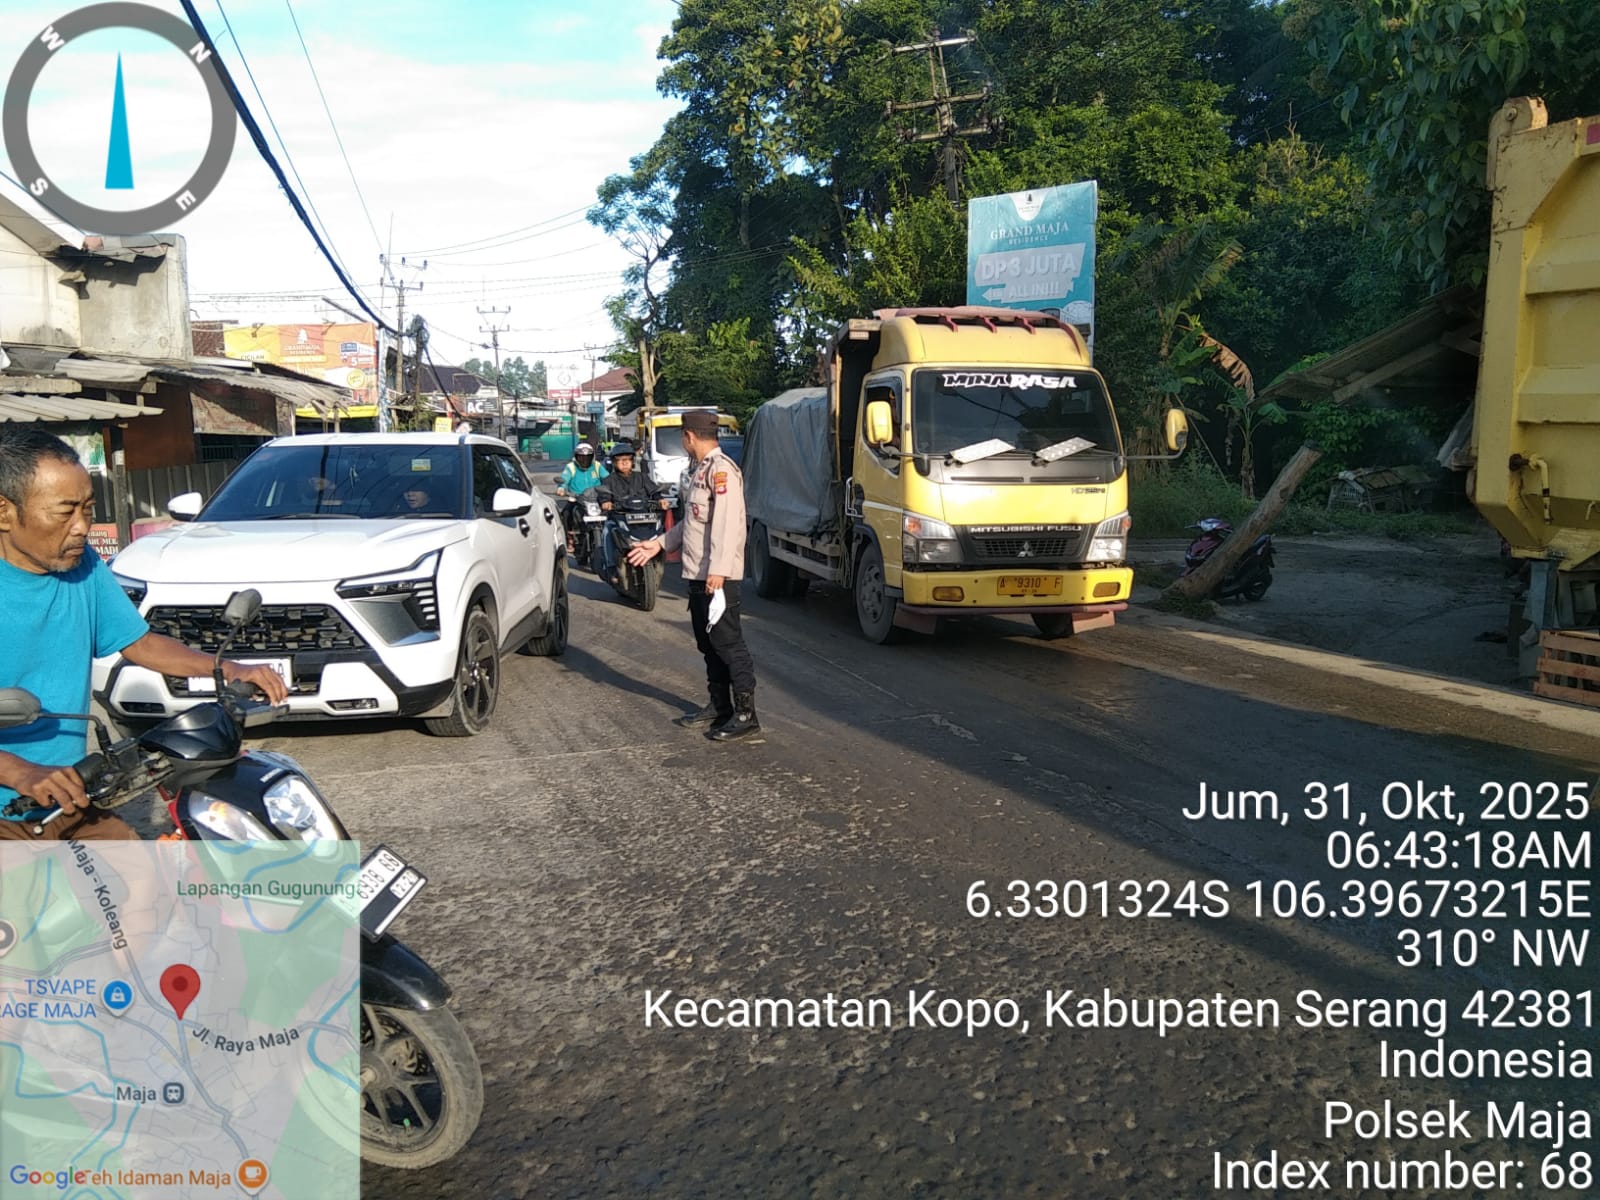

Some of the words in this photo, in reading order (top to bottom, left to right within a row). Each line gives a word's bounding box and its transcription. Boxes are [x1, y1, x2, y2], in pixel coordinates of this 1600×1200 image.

[990, 223, 1033, 240] GRAND
[1036, 221, 1069, 235] MAJA
[1024, 252, 1077, 276] JUTA
[467, 401, 484, 413] AC
[971, 525, 1044, 533] MITSUBISHI
[1047, 524, 1082, 532] FUSO
[999, 577, 1006, 588] A
[1017, 576, 1041, 588] 9310
